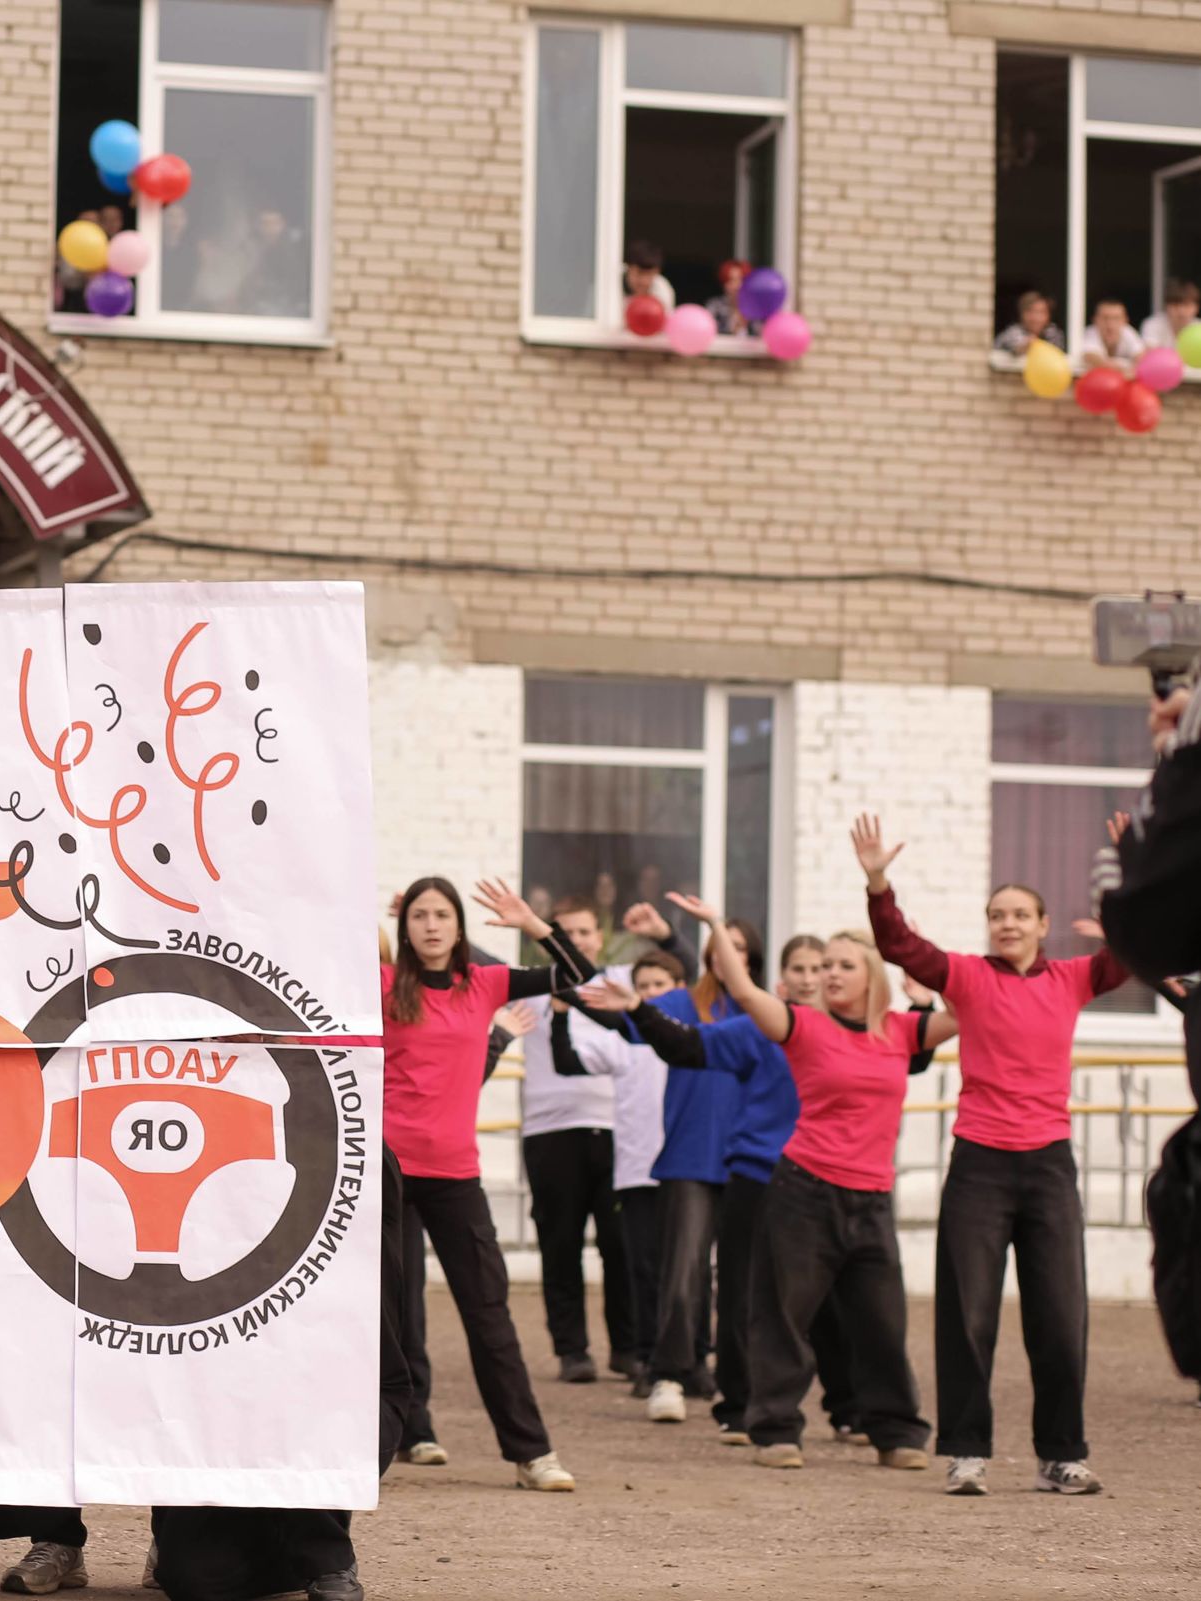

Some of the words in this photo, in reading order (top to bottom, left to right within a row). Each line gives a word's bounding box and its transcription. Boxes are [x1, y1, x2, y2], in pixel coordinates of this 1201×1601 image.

[85, 1045, 238, 1083] ГПОАУ
[127, 1119, 188, 1151] ЯО
[233, 1070, 366, 1341] ПОЛИТЕХНИЧЕСКИЙ
[79, 1317, 228, 1355] КОЛЛЕДЖ
